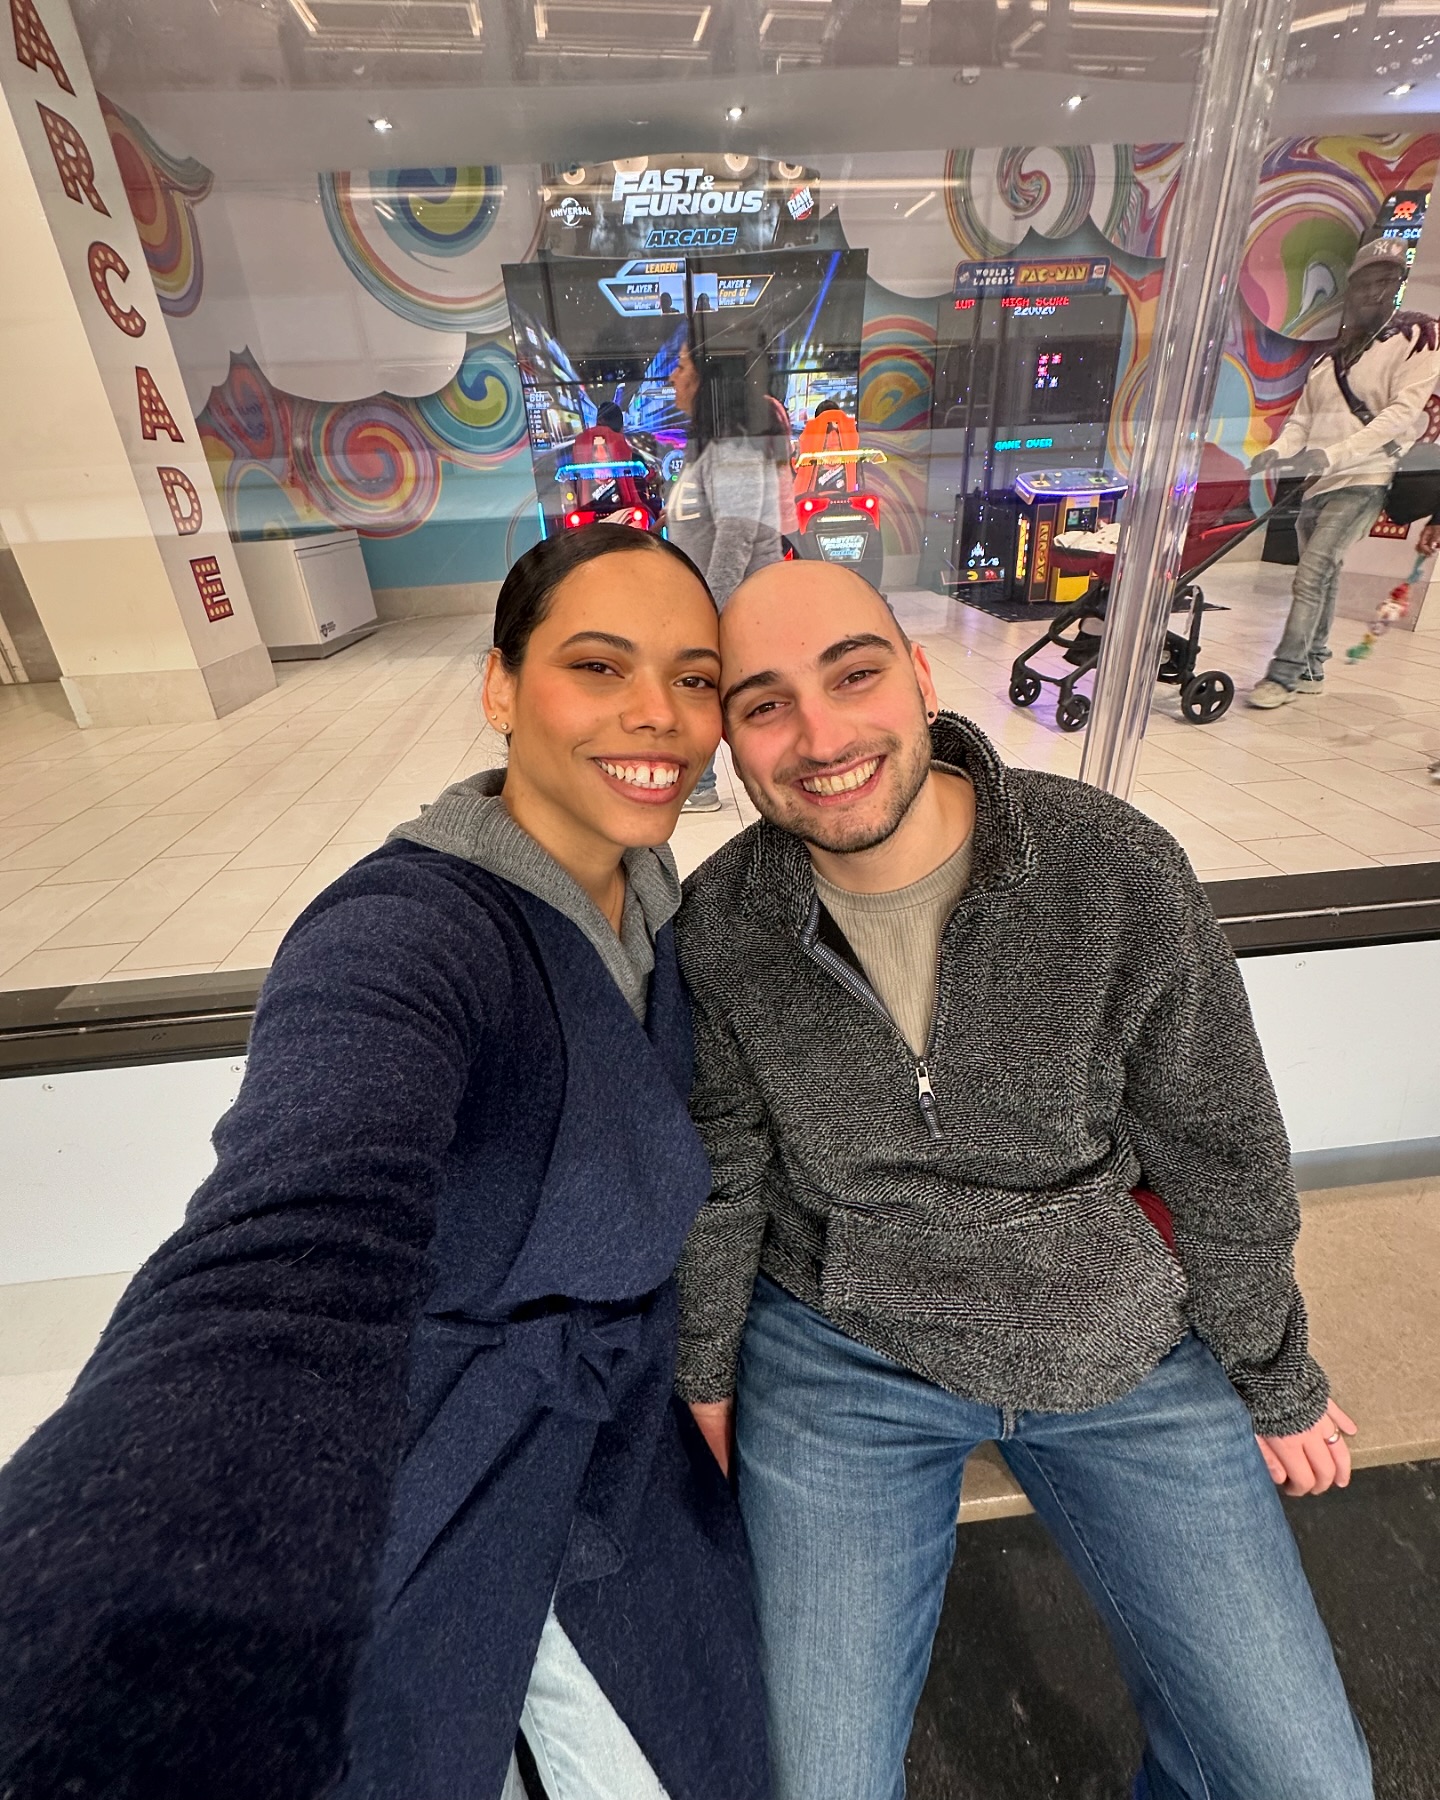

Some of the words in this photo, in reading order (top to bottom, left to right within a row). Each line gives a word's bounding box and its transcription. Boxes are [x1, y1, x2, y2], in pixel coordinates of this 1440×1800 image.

[612, 168, 704, 201] FAST
[787, 186, 812, 213] RAW
[550, 206, 591, 218] UNIVERSAL
[623, 190, 765, 225] FURIOUS
[645, 228, 738, 248] ARCADE
[645, 263, 678, 274] LEADER!
[975, 267, 1015, 277] WORLD'S
[1019, 266, 1088, 283] PAC-MAN
[718, 280, 744, 289] PLAYER
[746, 280, 752, 288] 2
[973, 276, 1015, 286] LARGEST
[627, 284, 653, 294] PLAYER
[719, 289, 737, 297] Ford
[10, 0, 234, 623] ARCADE
[1026, 438, 1053, 448] OVER
